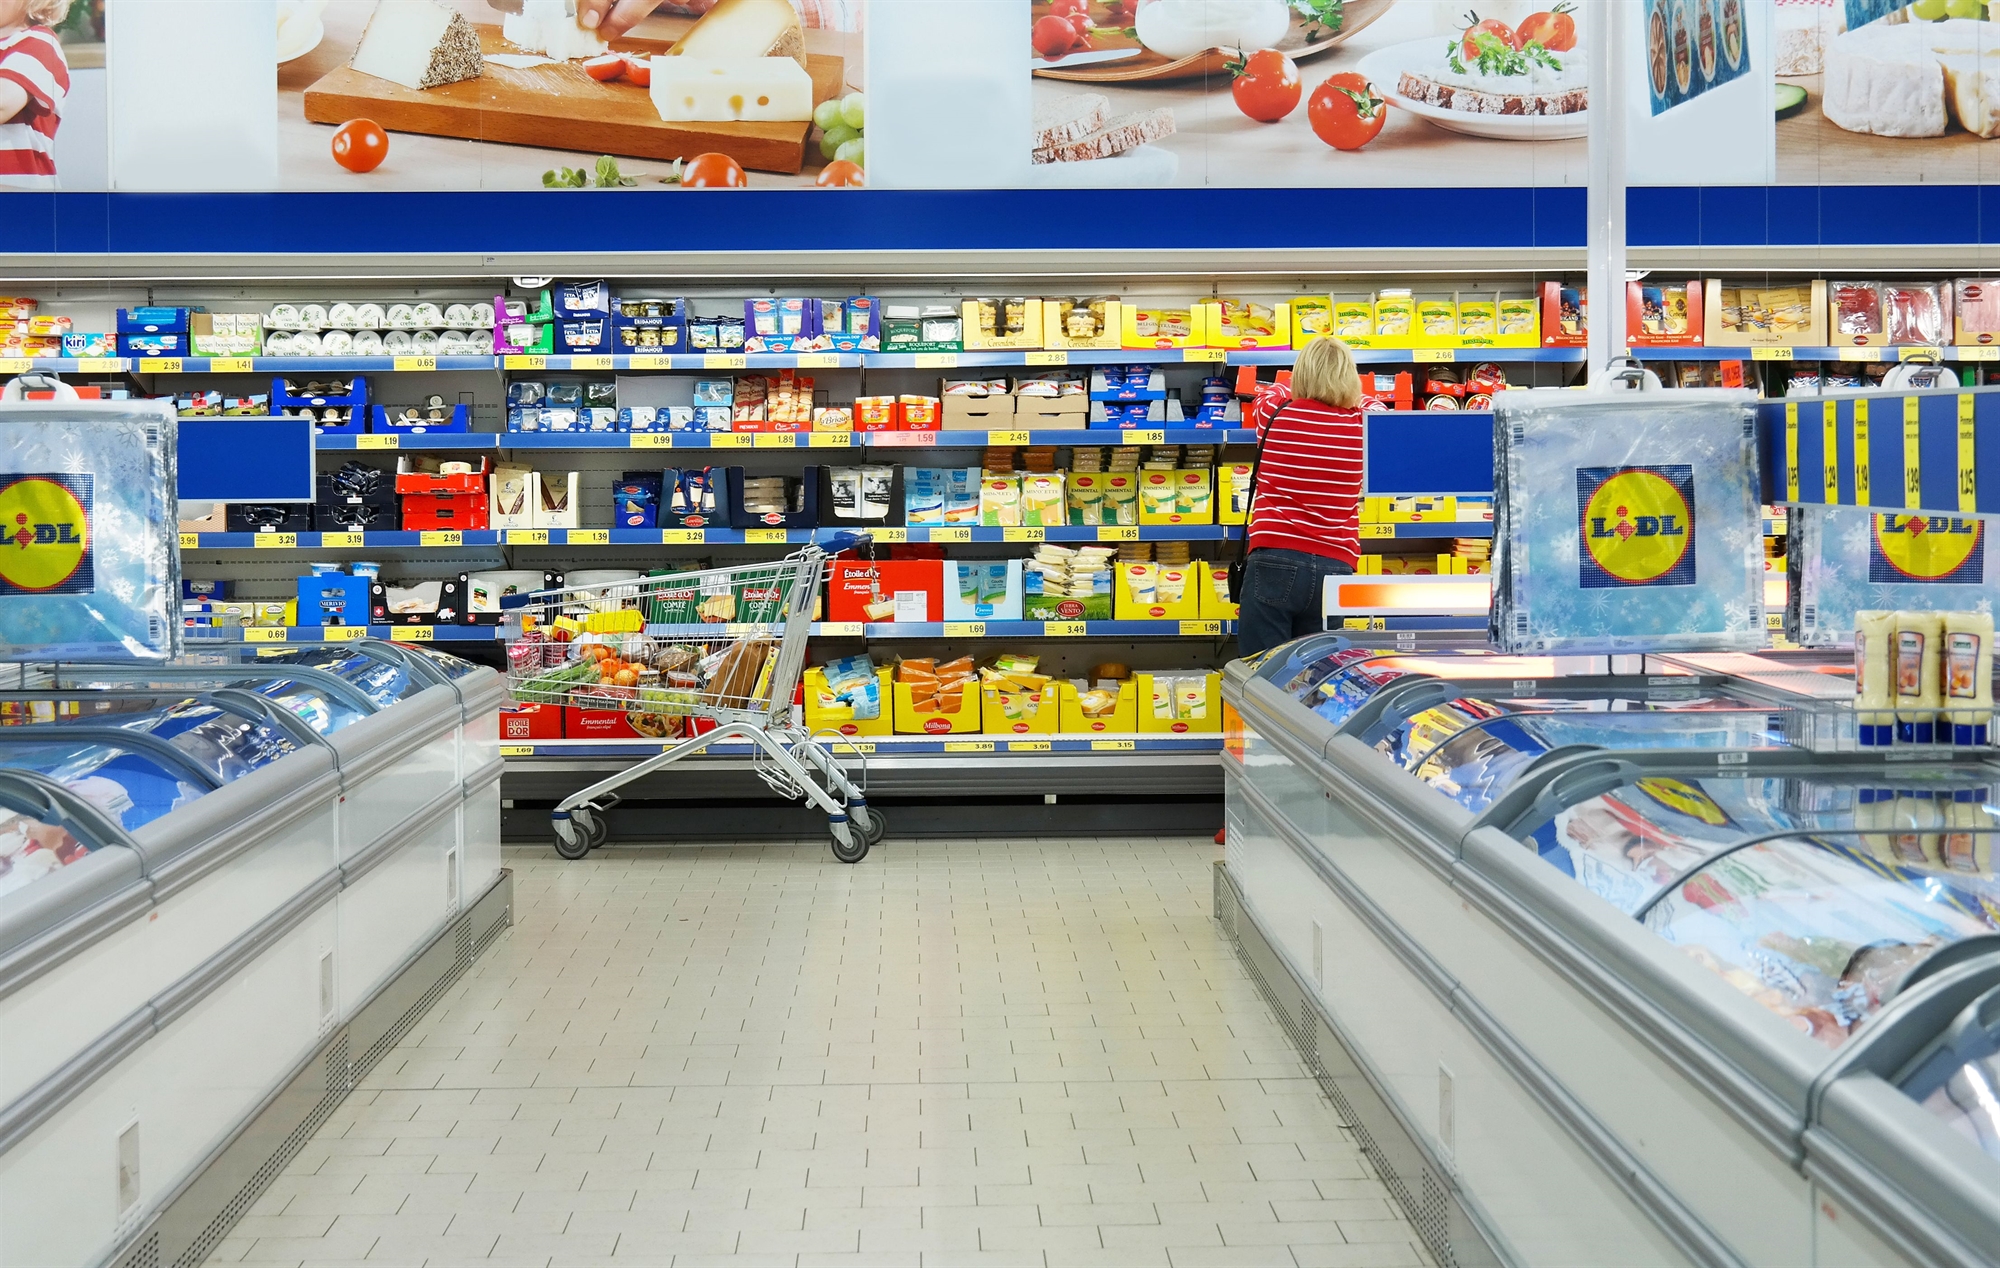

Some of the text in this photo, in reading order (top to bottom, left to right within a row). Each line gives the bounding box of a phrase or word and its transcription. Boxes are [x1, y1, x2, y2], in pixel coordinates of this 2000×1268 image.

[65, 335, 86, 348] kiri
[1048, 354, 1066, 362] 2.85
[1208, 351, 1223, 359] 2.19
[1436, 351, 1453, 359] 2.66
[1774, 350, 1791, 358] 2.29
[1861, 351, 1878, 359] 3.49
[1979, 350, 1997, 358] 2.49
[236, 360, 251, 368] 1.41
[417, 358, 434, 367] 0.65
[529, 358, 544, 366] 1.79
[595, 358, 611, 366] 1.69
[653, 357, 670, 366] 1.89
[729, 358, 744, 366] 1.29
[823, 356, 838, 364] 1.99
[940, 356, 955, 364] 2.19
[13, 361, 31, 369] 2.35
[101, 361, 119, 369] 2.30
[164, 361, 180, 370] 2.39
[384, 436, 397, 446] 1.19
[653, 435, 670, 444] 0.99
[735, 436, 750, 444] 1.99
[778, 435, 793, 443] 1.89
[832, 435, 849, 443] 2.22
[917, 433, 934, 442] 1.59
[1010, 433, 1028, 441] 2.45
[1147, 433, 1163, 441] 1.85
[1591, 504, 1683, 542] LIDL
[954, 530, 969, 539] 1.69
[1026, 530, 1044, 538] 2.29
[1121, 530, 1137, 538] 1.85
[1376, 526, 1392, 535] 2.39
[347, 535, 362, 543] 3.19
[444, 534, 460, 543] 2.99
[532, 533, 547, 541] 1.79
[592, 533, 608, 541] 1.39
[686, 532, 703, 540] 3.29
[765, 532, 785, 540] 16.45
[888, 531, 905, 540] 2.39
[180, 537, 196, 545] 3.99
[279, 536, 295, 544] 3.29
[662, 600, 686, 609] COMTÉ
[844, 624, 861, 632] 6.25
[969, 625, 984, 633] 1.69
[1067, 625, 1084, 633] 3.49
[1204, 623, 1219, 632] 1.99
[1366, 622, 1384, 631] 249
[268, 630, 285, 639] 0.69
[347, 630, 365, 638] 0.85
[415, 630, 432, 638] 2.29
[580, 717, 617, 725] Emmental
[923, 721, 951, 730] Milbona
[508, 727, 529, 735] D'OR
